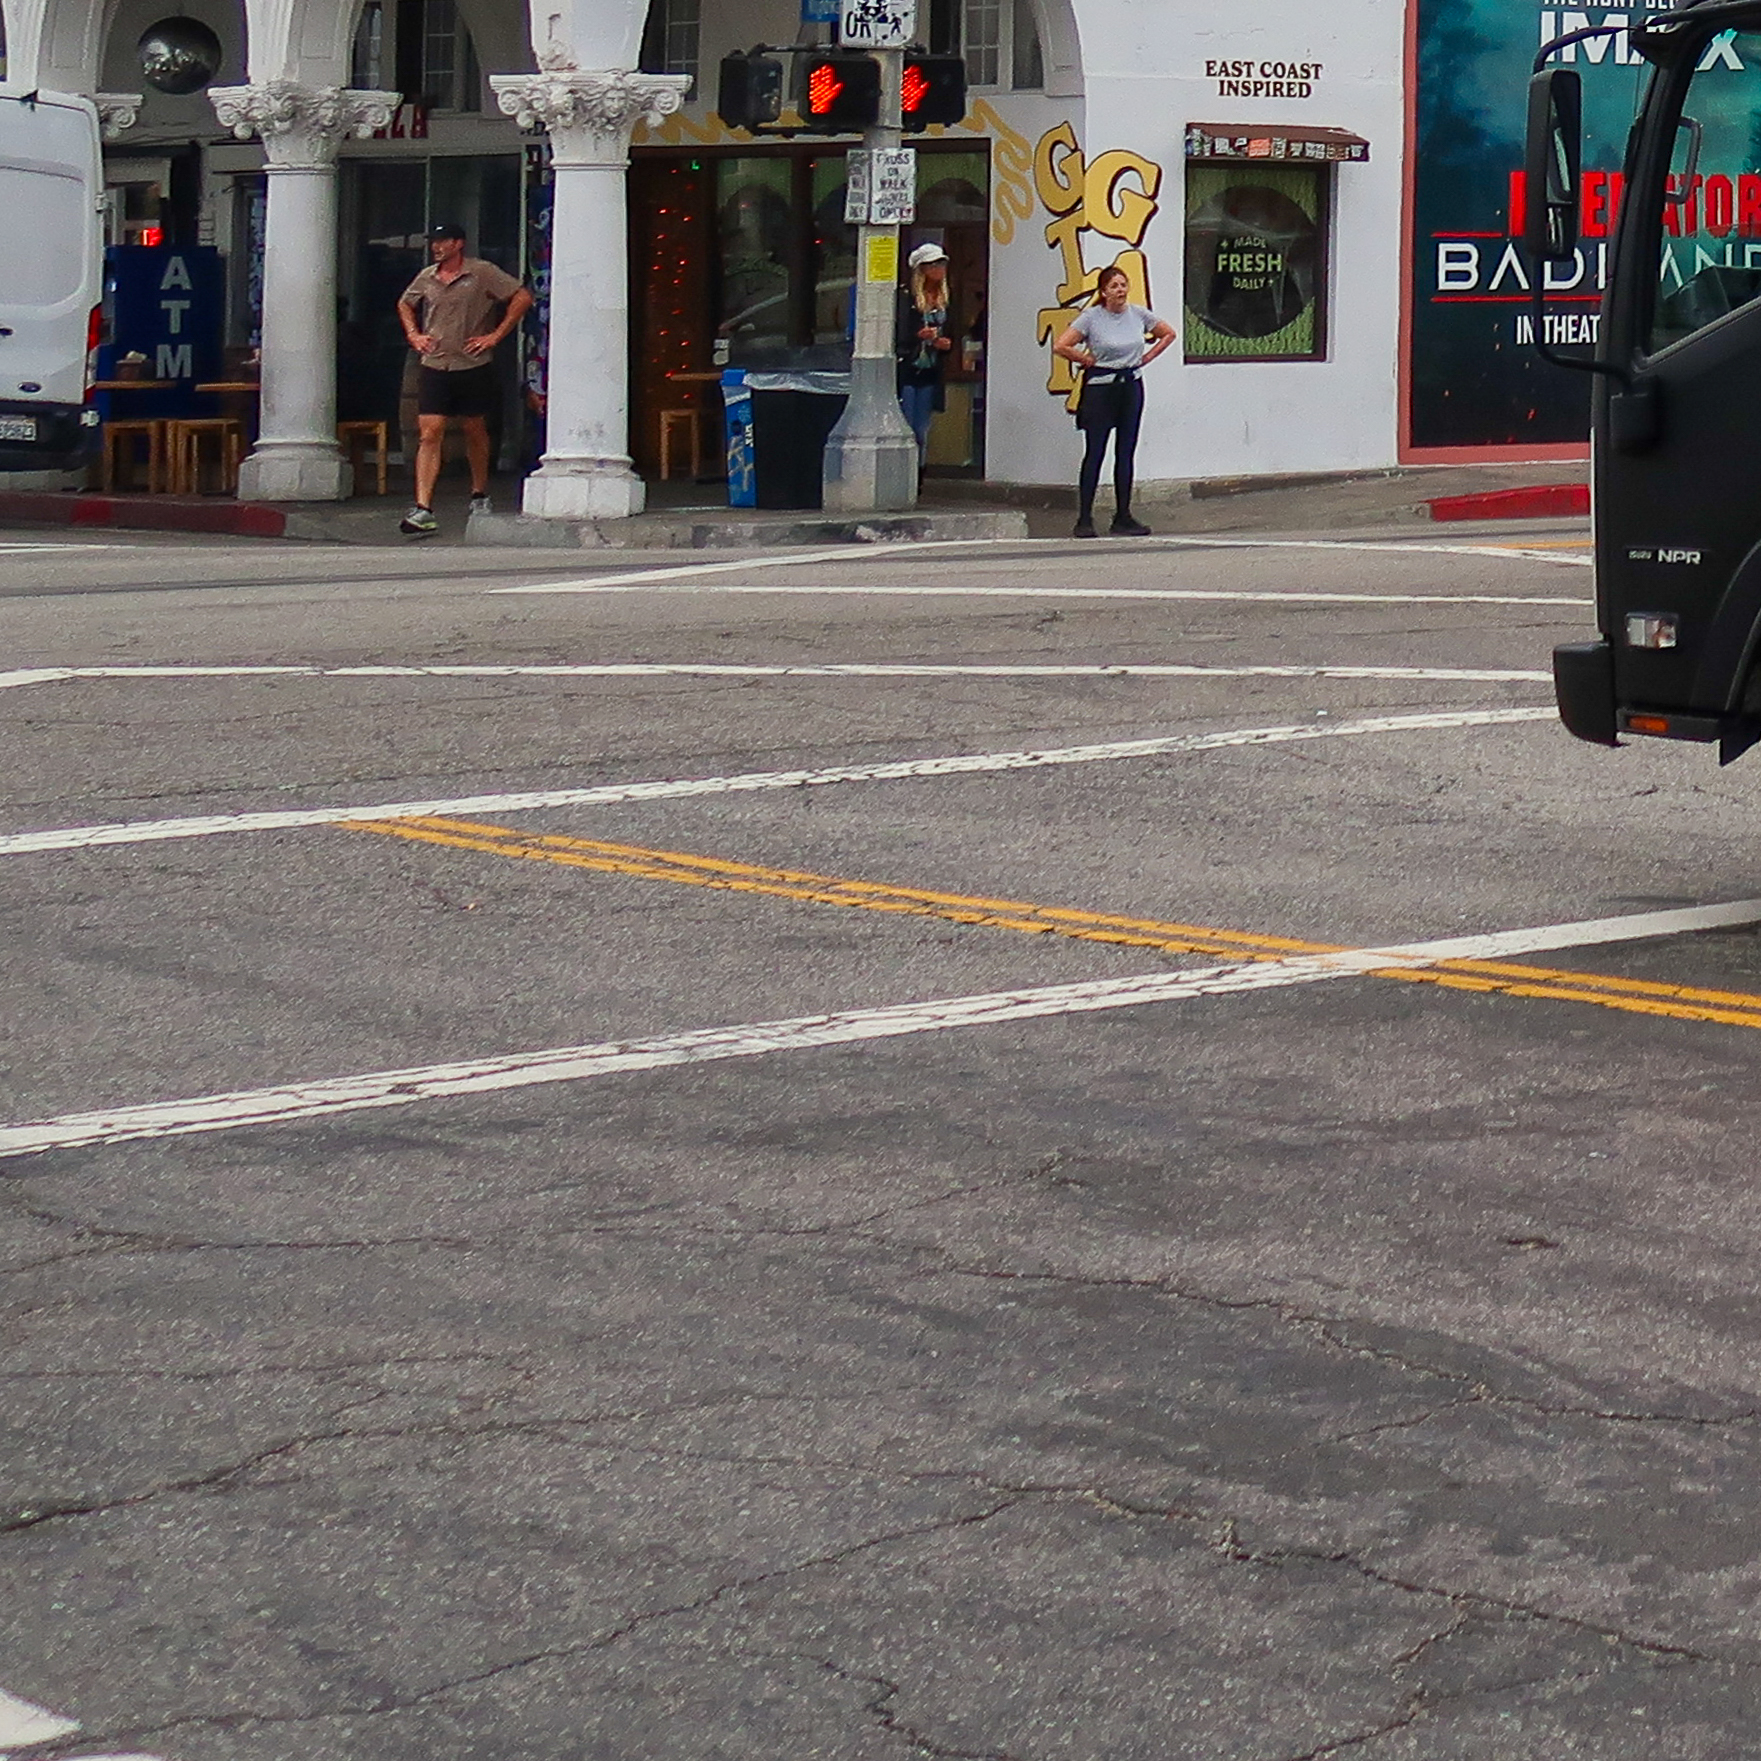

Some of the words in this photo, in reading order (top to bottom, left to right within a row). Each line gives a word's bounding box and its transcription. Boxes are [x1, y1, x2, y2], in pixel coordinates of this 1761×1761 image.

[1205, 60, 1254, 78] EAST
[1260, 61, 1324, 80] COAST
[1218, 80, 1312, 99] INSPIRED
[1217, 253, 1282, 273] FRESH
[1233, 277, 1266, 289] DAILY
[156, 256, 193, 379] ATM
[1657, 548, 1702, 565] NPR
